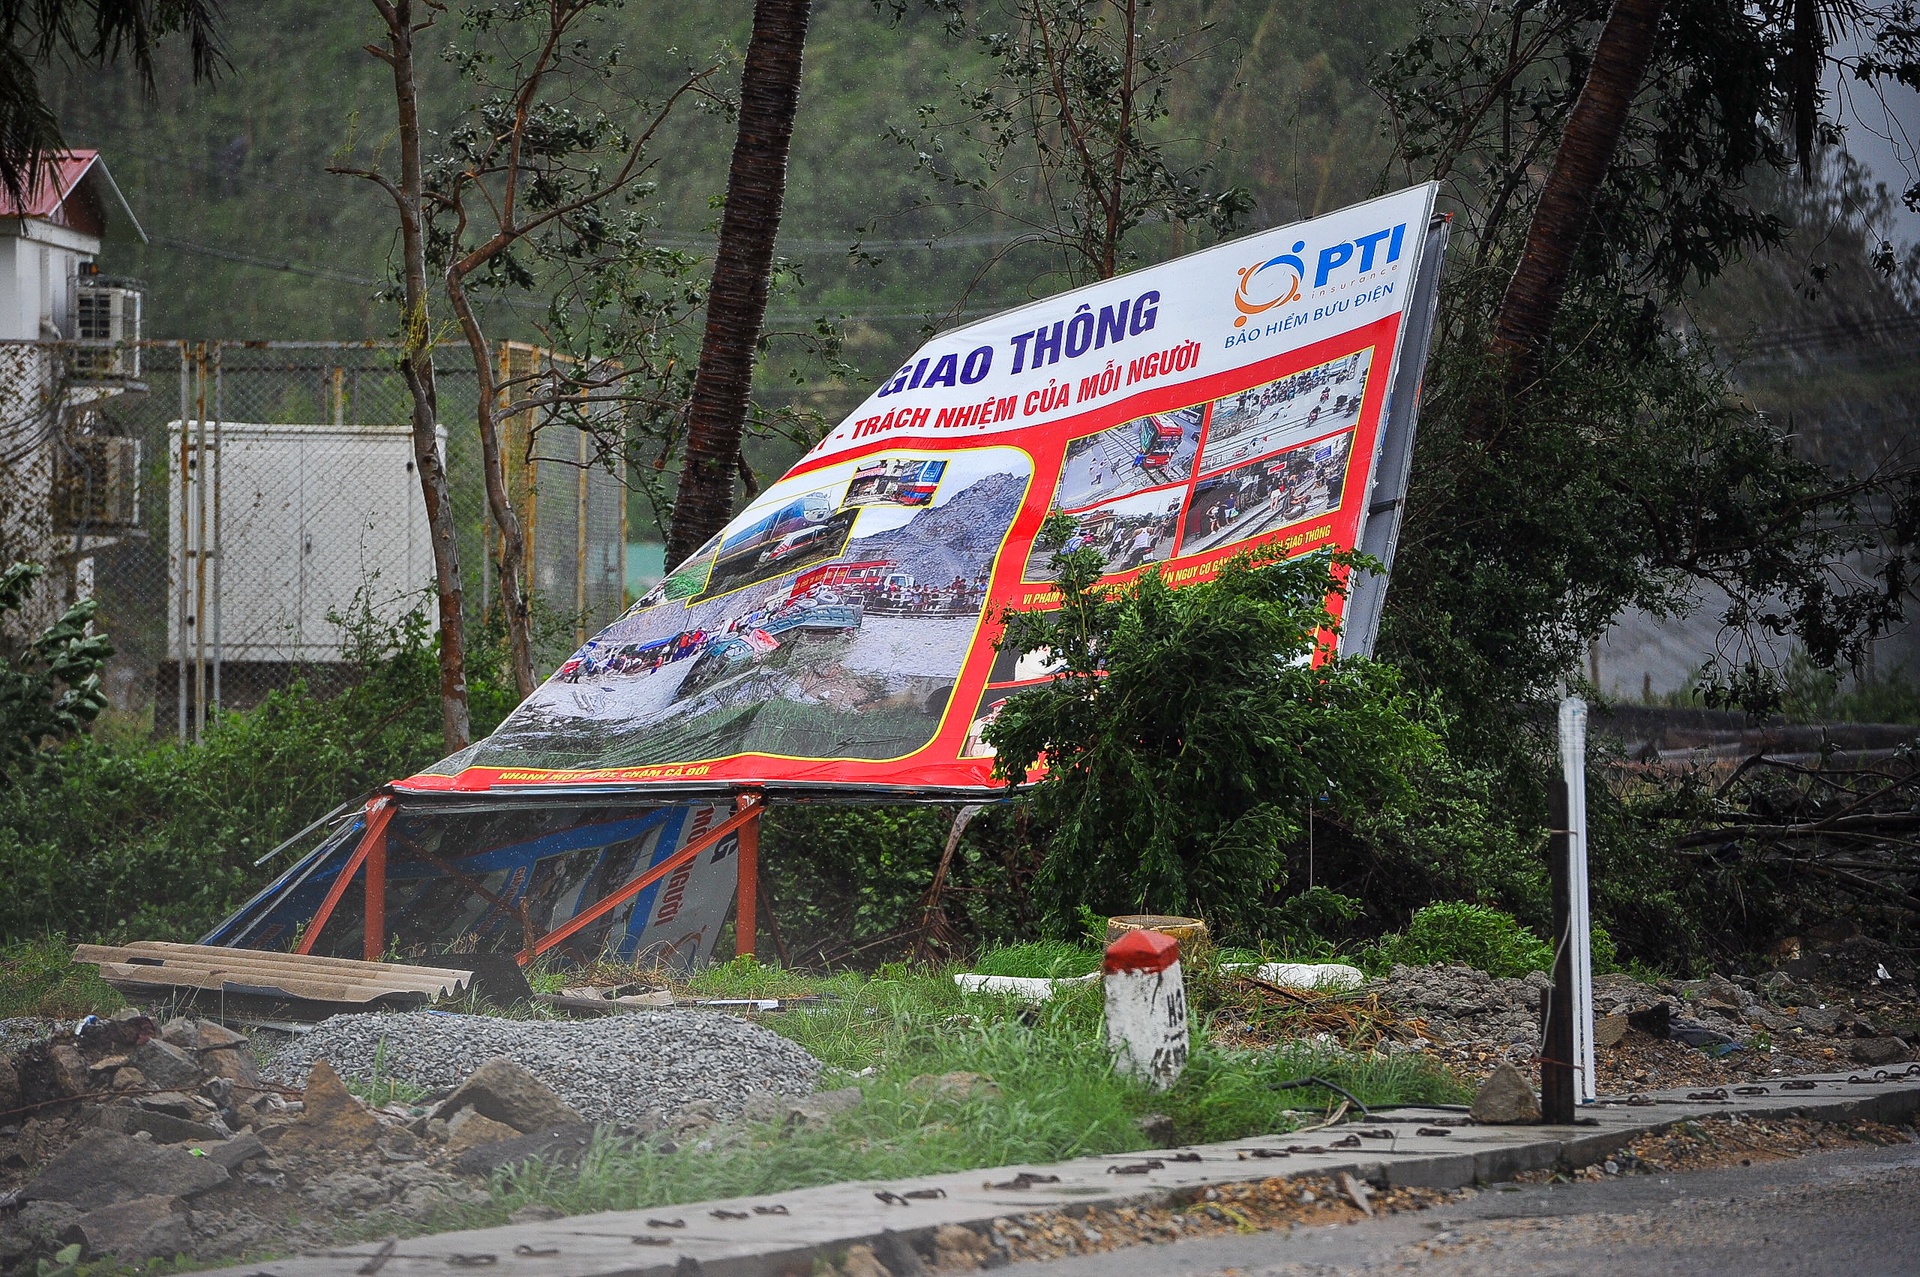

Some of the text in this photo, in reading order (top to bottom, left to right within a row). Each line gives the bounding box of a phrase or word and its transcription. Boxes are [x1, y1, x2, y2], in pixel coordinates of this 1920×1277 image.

[1311, 264, 1398, 299] insurance
[1314, 223, 1406, 288] PTI
[877, 290, 1161, 398] GIAO THÔNG
[1224, 282, 1395, 349] BẢO HIỂM BƯU ĐIỆN
[851, 406, 931, 440] TRÁCH
[934, 394, 1019, 430] NHIỆM
[1023, 378, 1070, 417] CỦA
[1076, 358, 1123, 403] MỖI
[1126, 339, 1202, 386] NGƯỜI
[1022, 593, 1032, 605] VI
[1033, 591, 1061, 606] PHẠM
[1175, 566, 1198, 582] NGUY
[1199, 561, 1211, 576] CƠ
[1304, 524, 1332, 545] THÔNG
[498, 772, 547, 781] NHANH
